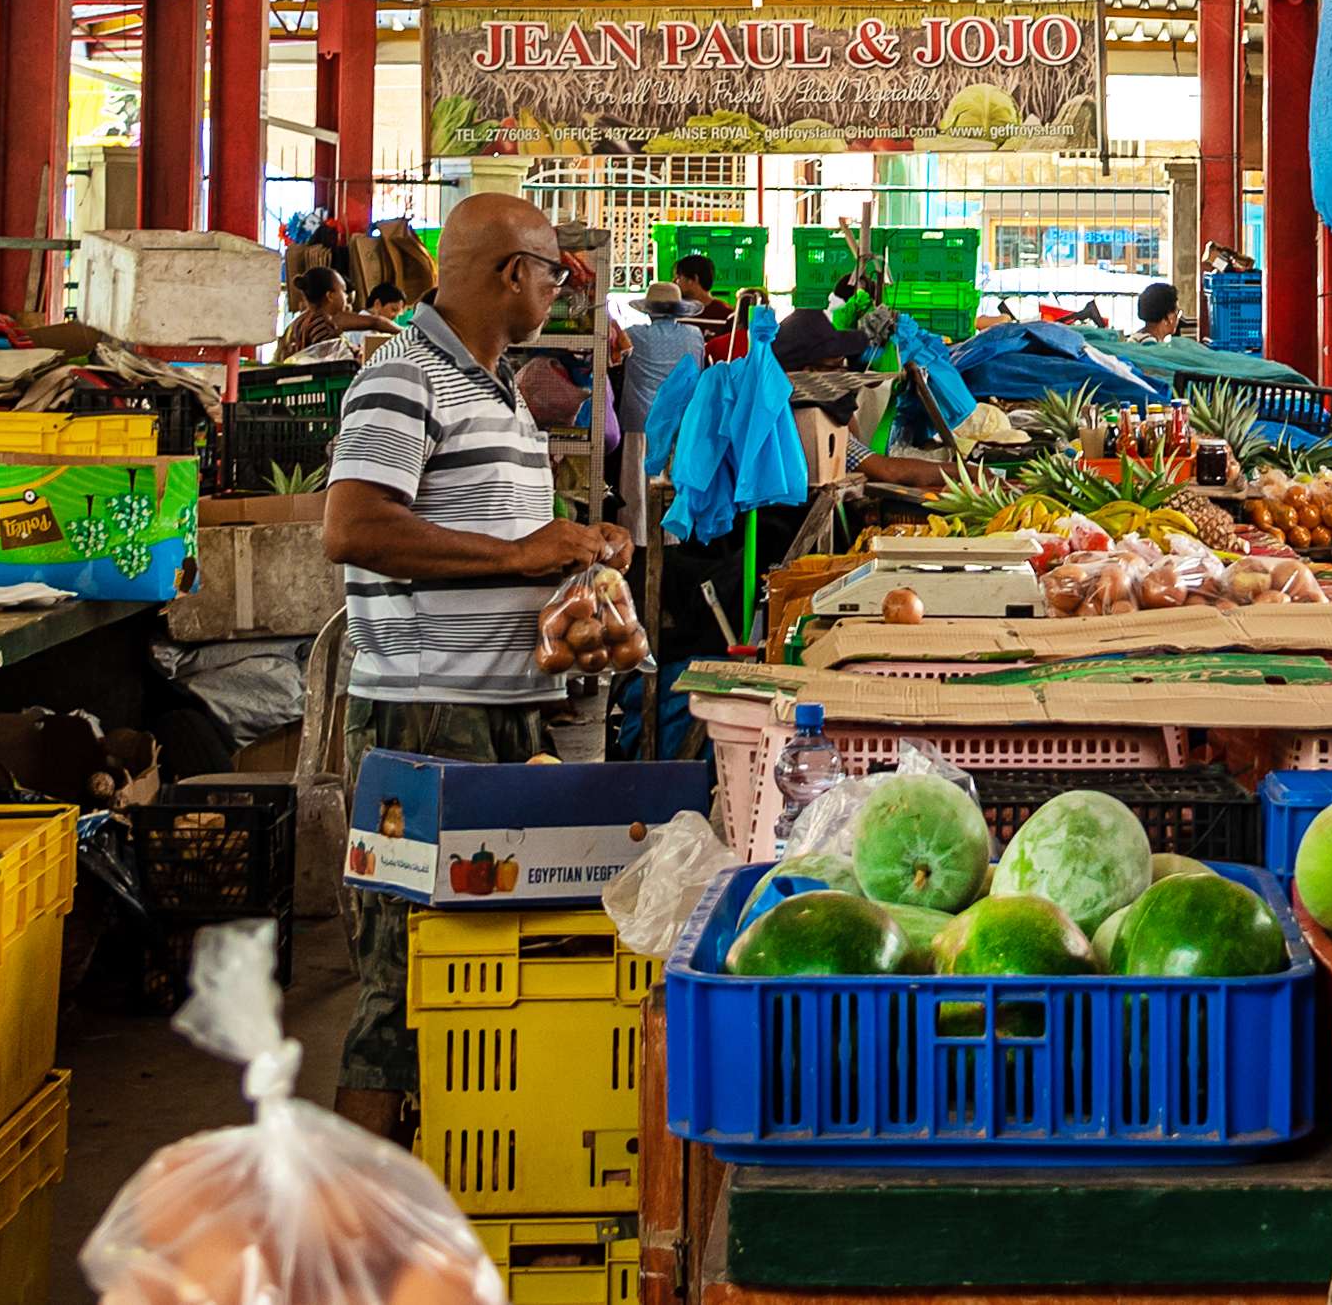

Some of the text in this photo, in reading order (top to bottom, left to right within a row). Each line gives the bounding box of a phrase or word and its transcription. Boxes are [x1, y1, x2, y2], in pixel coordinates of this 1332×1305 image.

[473, 14, 1082, 70] JEAN PAUL & JOJO
[582, 76, 942, 118] For all Your Fresh & Local Vegetables
[455, 128, 483, 142] TEL:
[485, 128, 541, 142] 2776083
[553, 127, 603, 142] OFFICE:
[604, 127, 661, 141] 4372277
[673, 127, 708, 141] ANSE
[710, 127, 751, 140] ROYAL
[528, 864, 626, 884] EGYPTIAN VEGET
